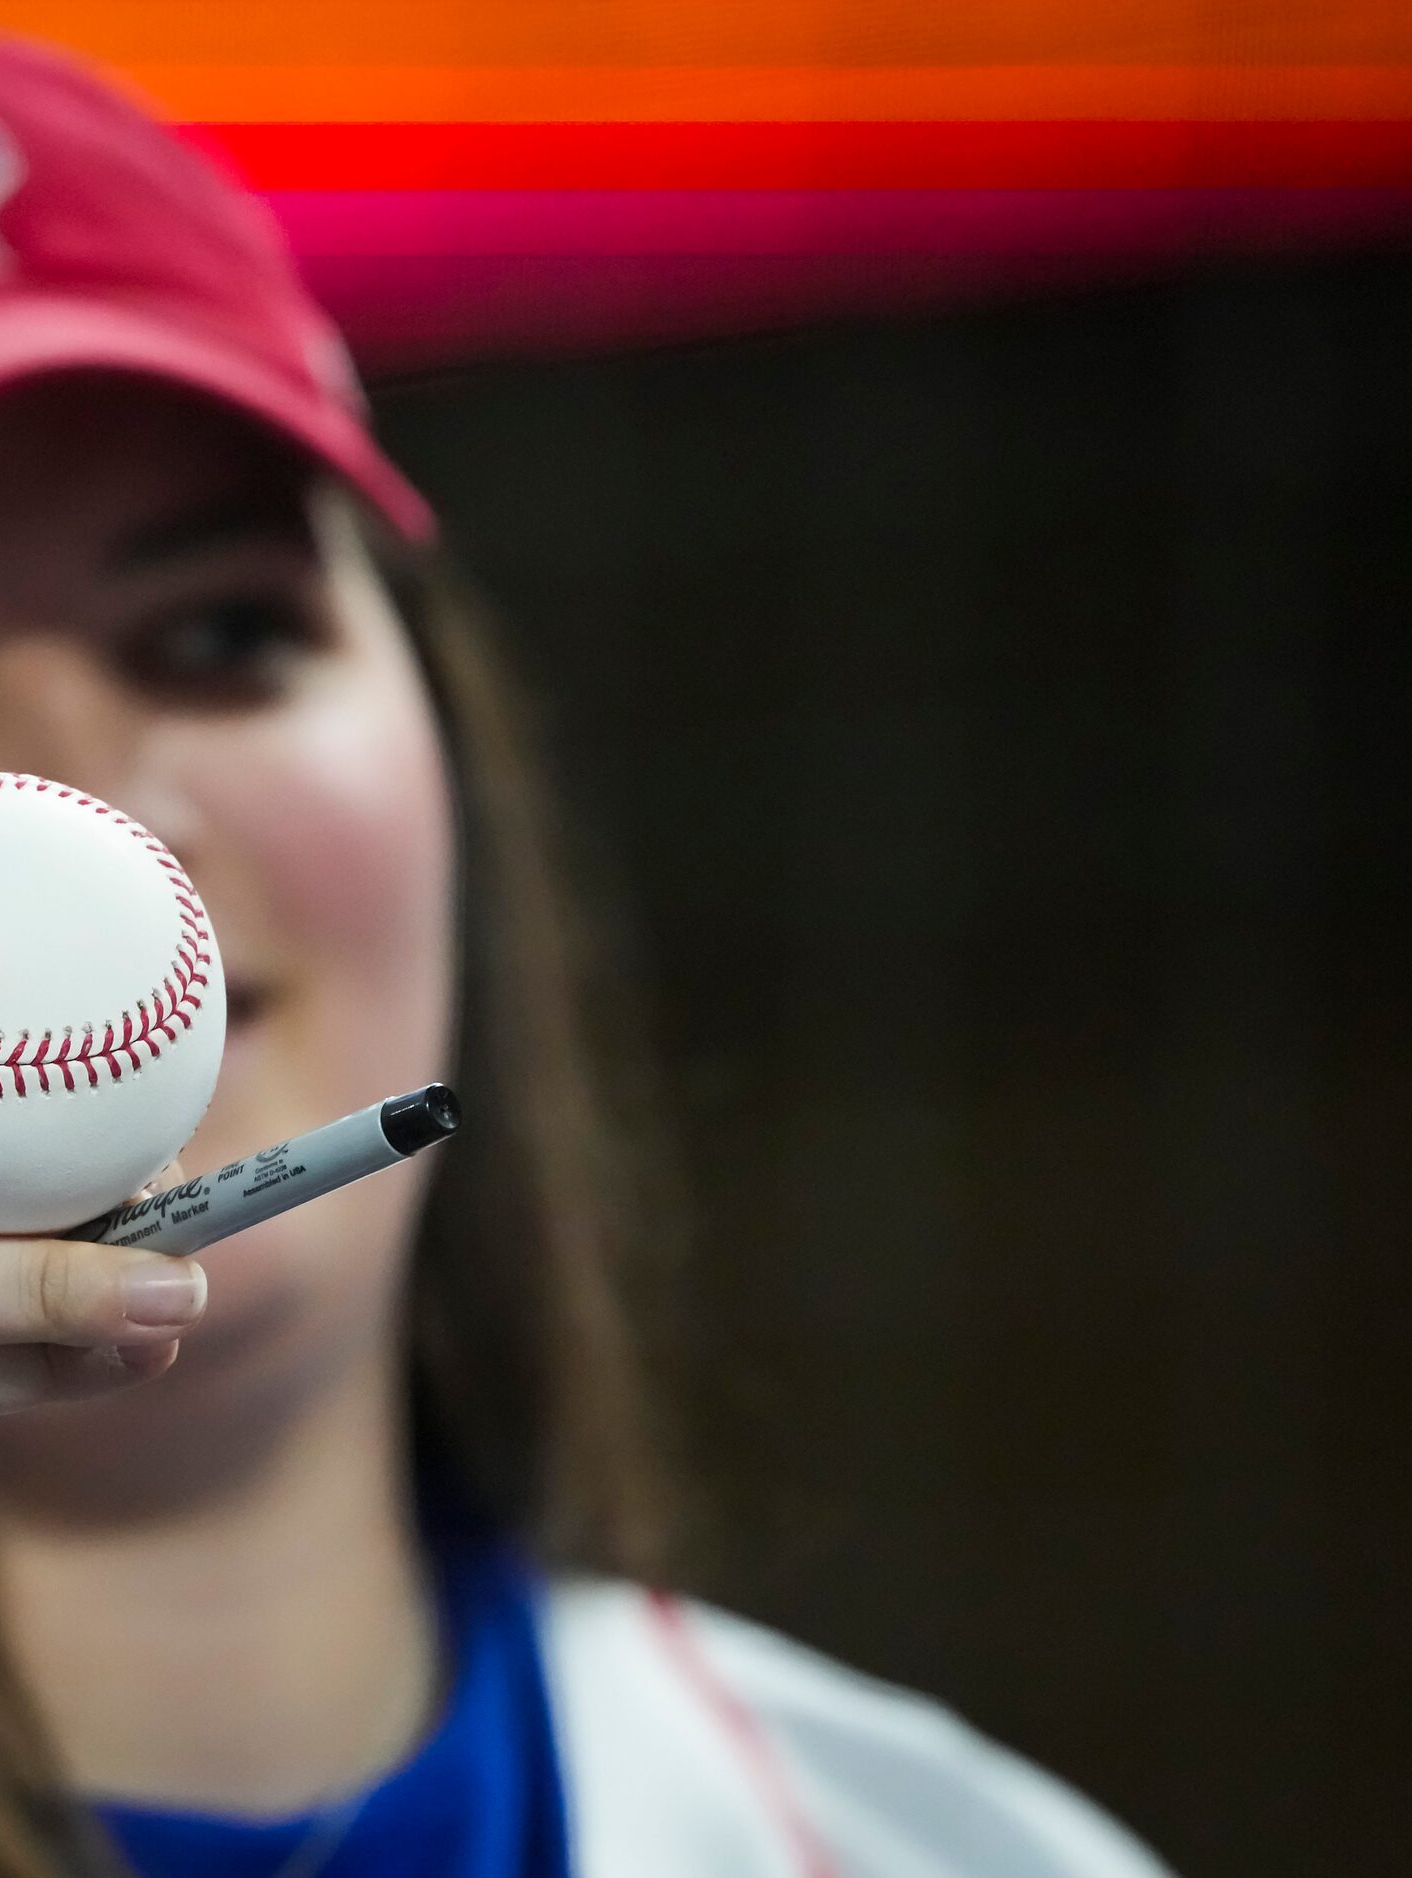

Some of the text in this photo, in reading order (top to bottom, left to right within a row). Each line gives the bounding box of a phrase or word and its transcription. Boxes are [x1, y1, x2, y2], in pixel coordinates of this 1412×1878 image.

[218, 1164, 245, 1183] POINT
[243, 1175, 281, 1197] Assembled
[290, 1165, 306, 1177] USA
[104, 1200, 209, 1247] rmanent Marker
